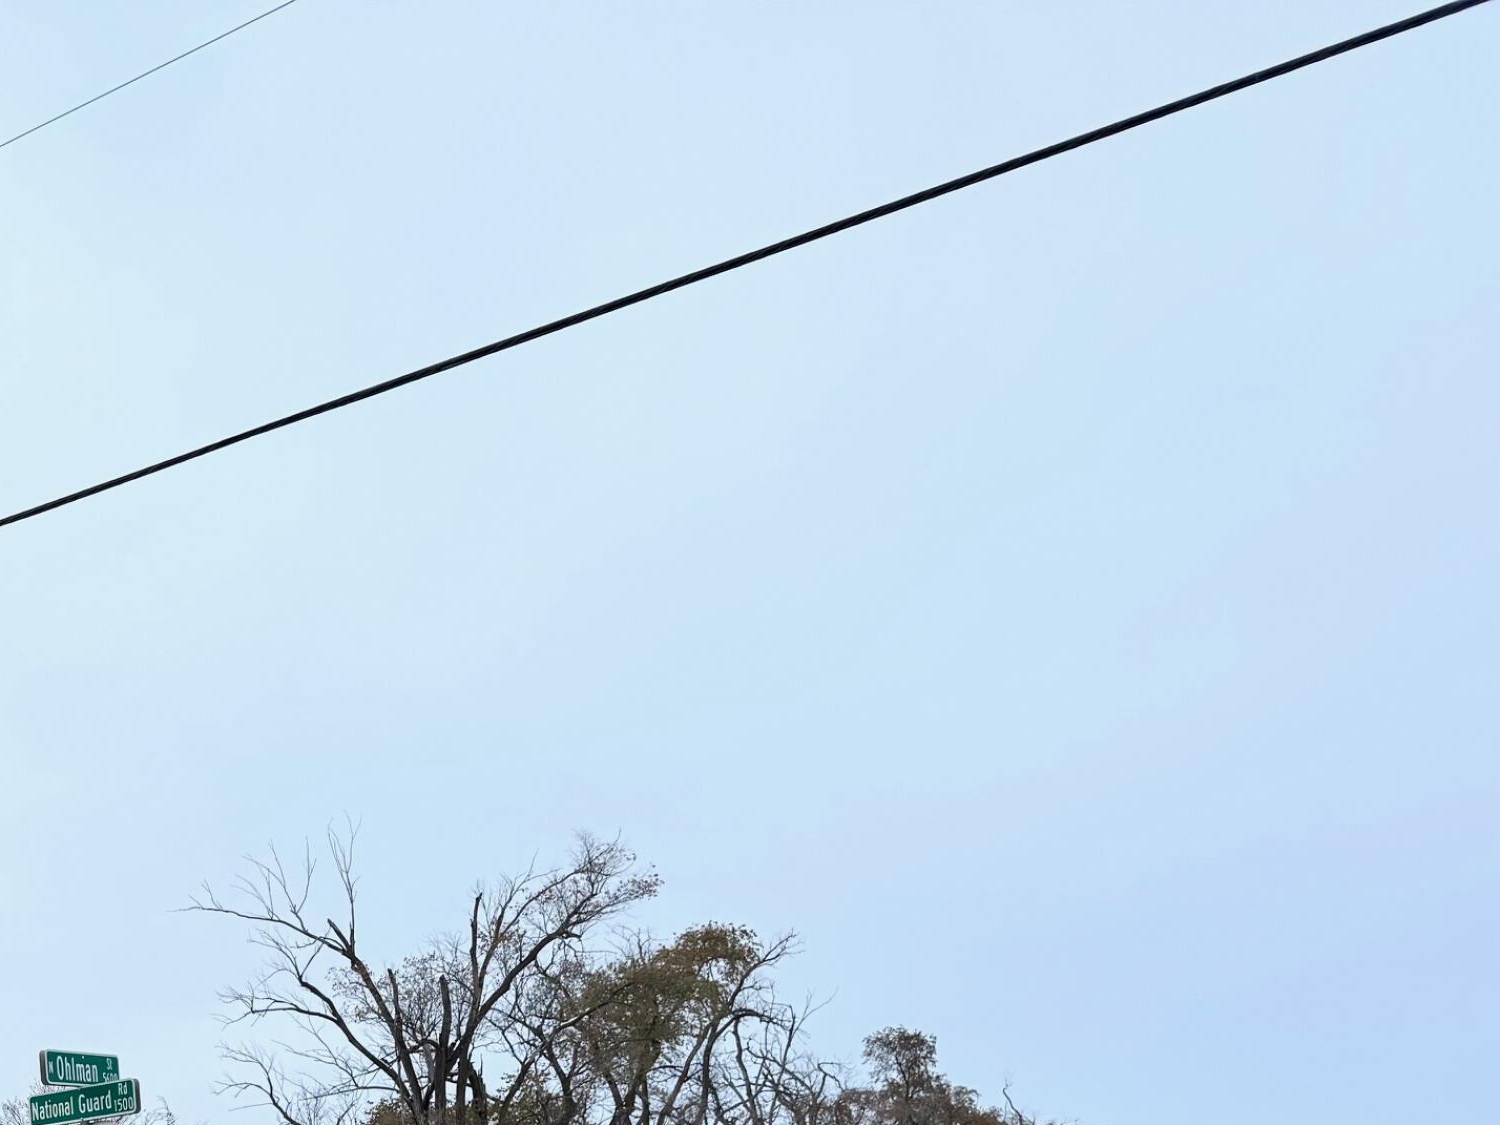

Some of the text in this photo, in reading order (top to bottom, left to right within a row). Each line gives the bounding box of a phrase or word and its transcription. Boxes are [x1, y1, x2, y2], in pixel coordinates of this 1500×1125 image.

[56, 1055, 99, 1083] Ohlman
[31, 1082, 128, 1121] National Guard Rd
[113, 1096, 134, 1112] 1500
